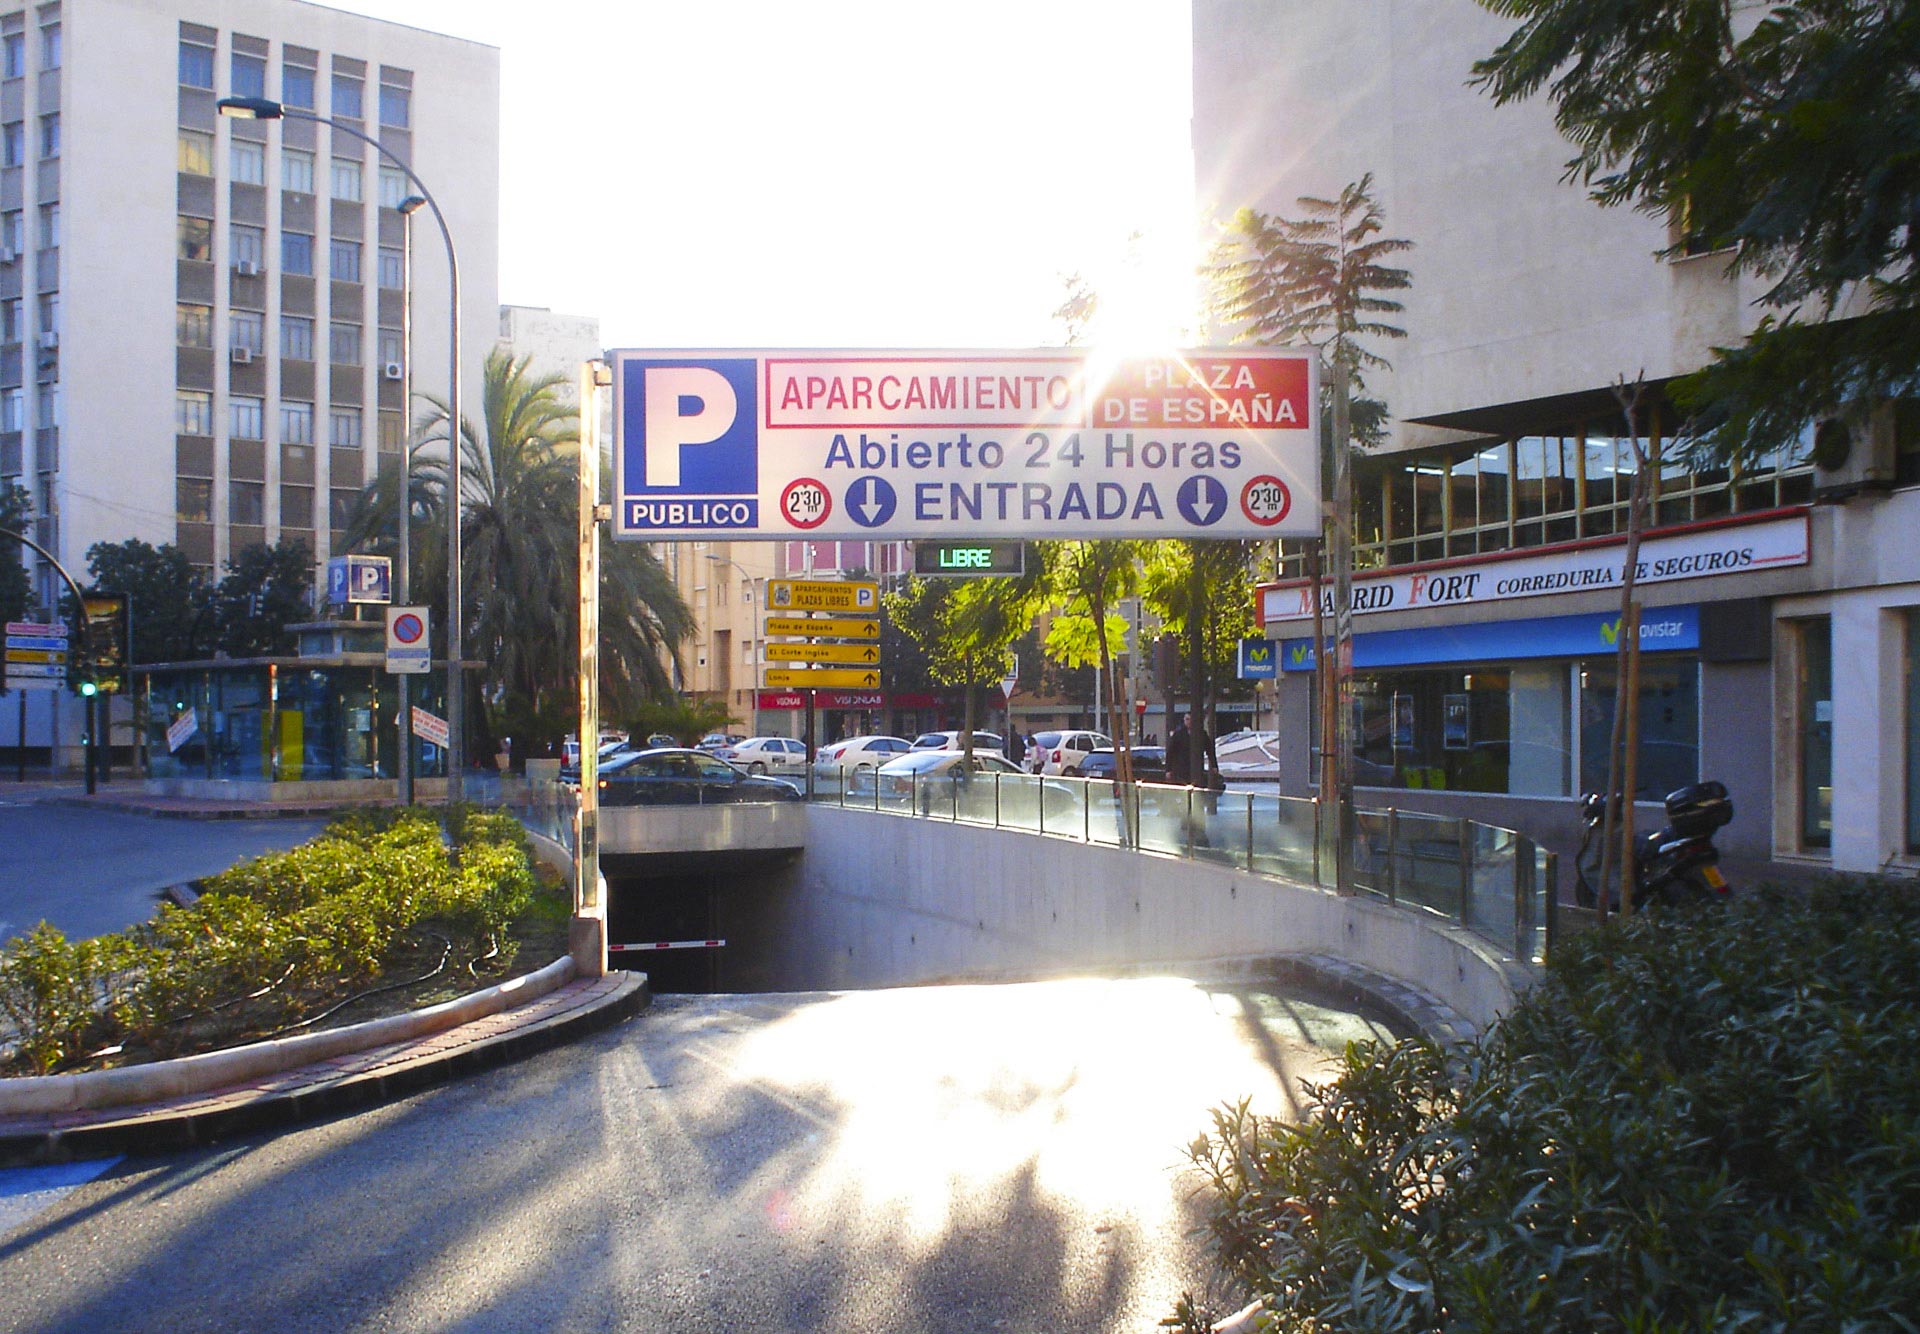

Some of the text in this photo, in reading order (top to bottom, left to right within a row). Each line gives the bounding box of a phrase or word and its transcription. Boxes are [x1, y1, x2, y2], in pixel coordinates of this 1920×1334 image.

[1145, 364, 1256, 390] PLAZA
[781, 376, 1073, 411] APARCAMIENTO
[1104, 392, 1297, 423] DE ESPAÑA
[645, 367, 737, 486] P
[825, 432, 1242, 469] Abierto 24 Horas
[632, 503, 750, 526] PUBLICO
[915, 482, 1164, 521] ENTRADA
[939, 549, 992, 568] LIBRE
[1496, 567, 1613, 595] CORREDURIA
[1653, 548, 1753, 577] SEGUROS
[361, 567, 379, 591] P
[1298, 573, 1481, 616] MARID FORT
[858, 589, 870, 604] P
[1627, 621, 1683, 640] ovistar
